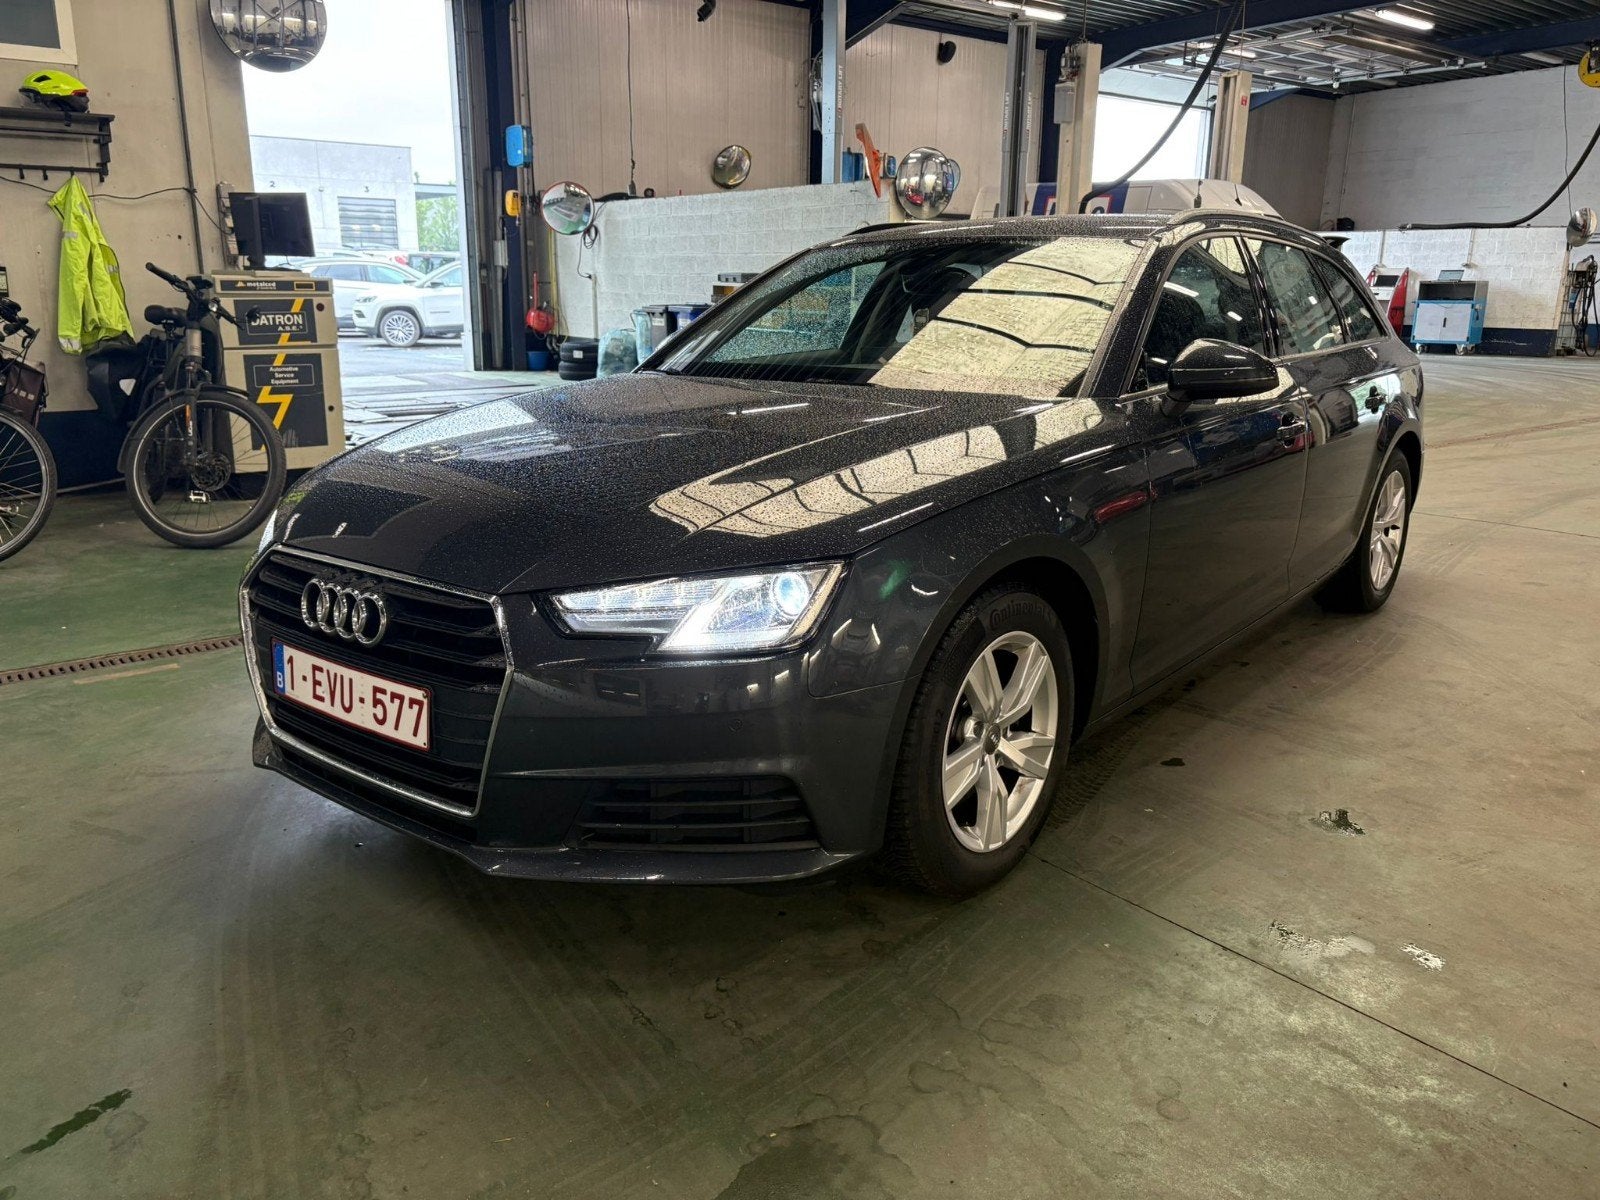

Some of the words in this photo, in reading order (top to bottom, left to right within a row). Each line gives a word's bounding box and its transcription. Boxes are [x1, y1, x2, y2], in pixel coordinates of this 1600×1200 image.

[269, 180, 276, 188] 2
[276, 671, 284, 689] B
[287, 655, 425, 738] 1-EVU-577
